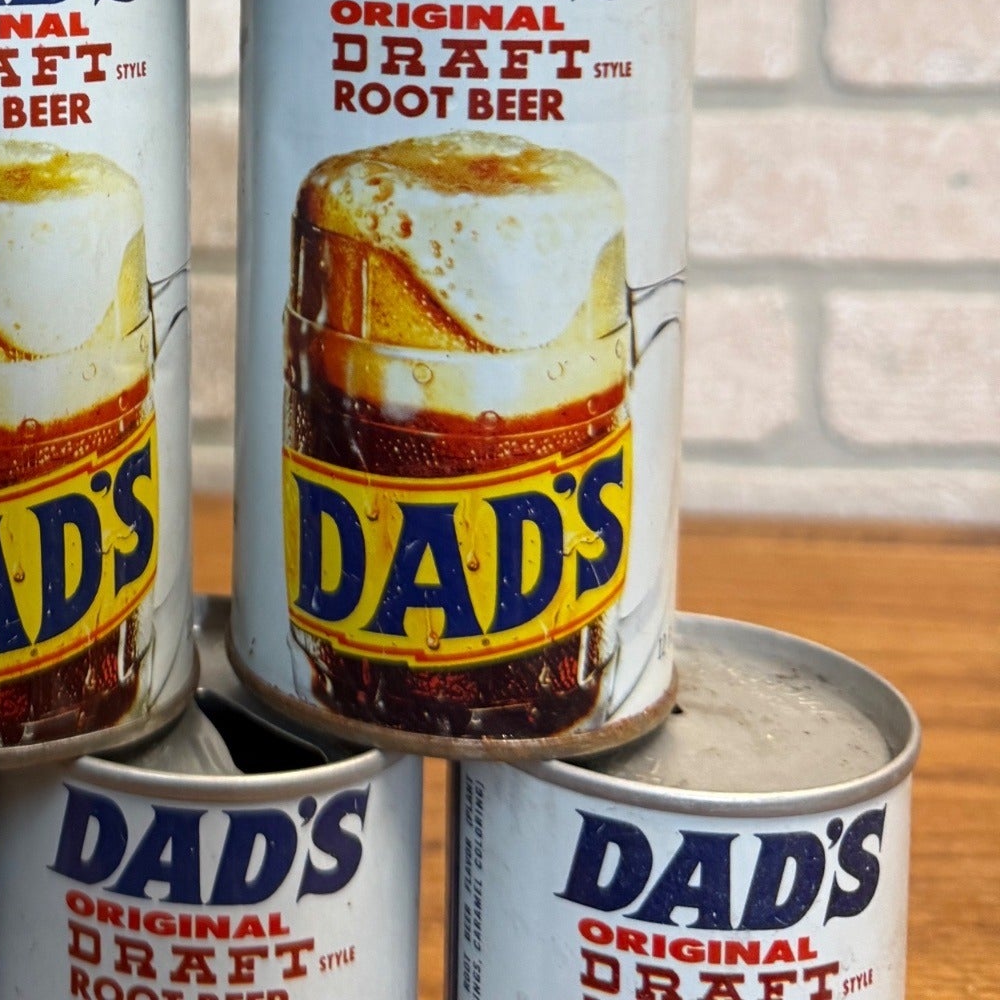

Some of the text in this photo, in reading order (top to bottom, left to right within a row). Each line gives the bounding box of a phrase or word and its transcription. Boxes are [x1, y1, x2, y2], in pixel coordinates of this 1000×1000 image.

[329, 0, 565, 31] ORIGINAL
[116, 60, 147, 79] STYLE
[332, 32, 632, 79] DRAFT STYLE
[3, 93, 92, 129] BEER
[333, 79, 565, 121] ROOT BEER
[292, 445, 624, 639] DAD'S
[46, 782, 371, 903] DAD'S
[473, 780, 484, 871] COLORING)
[553, 803, 887, 931] DAD'S
[65, 889, 290, 940] ORIGINAL
[463, 904, 472, 943] BEER
[472, 878, 482, 952] CARAMEL
[67, 919, 355, 985] DRAFT STYLE
[577, 918, 817, 966] ORIGINAL
[462, 951, 471, 993] ROOT
[580, 947, 873, 1000] DRAFT STYLE
